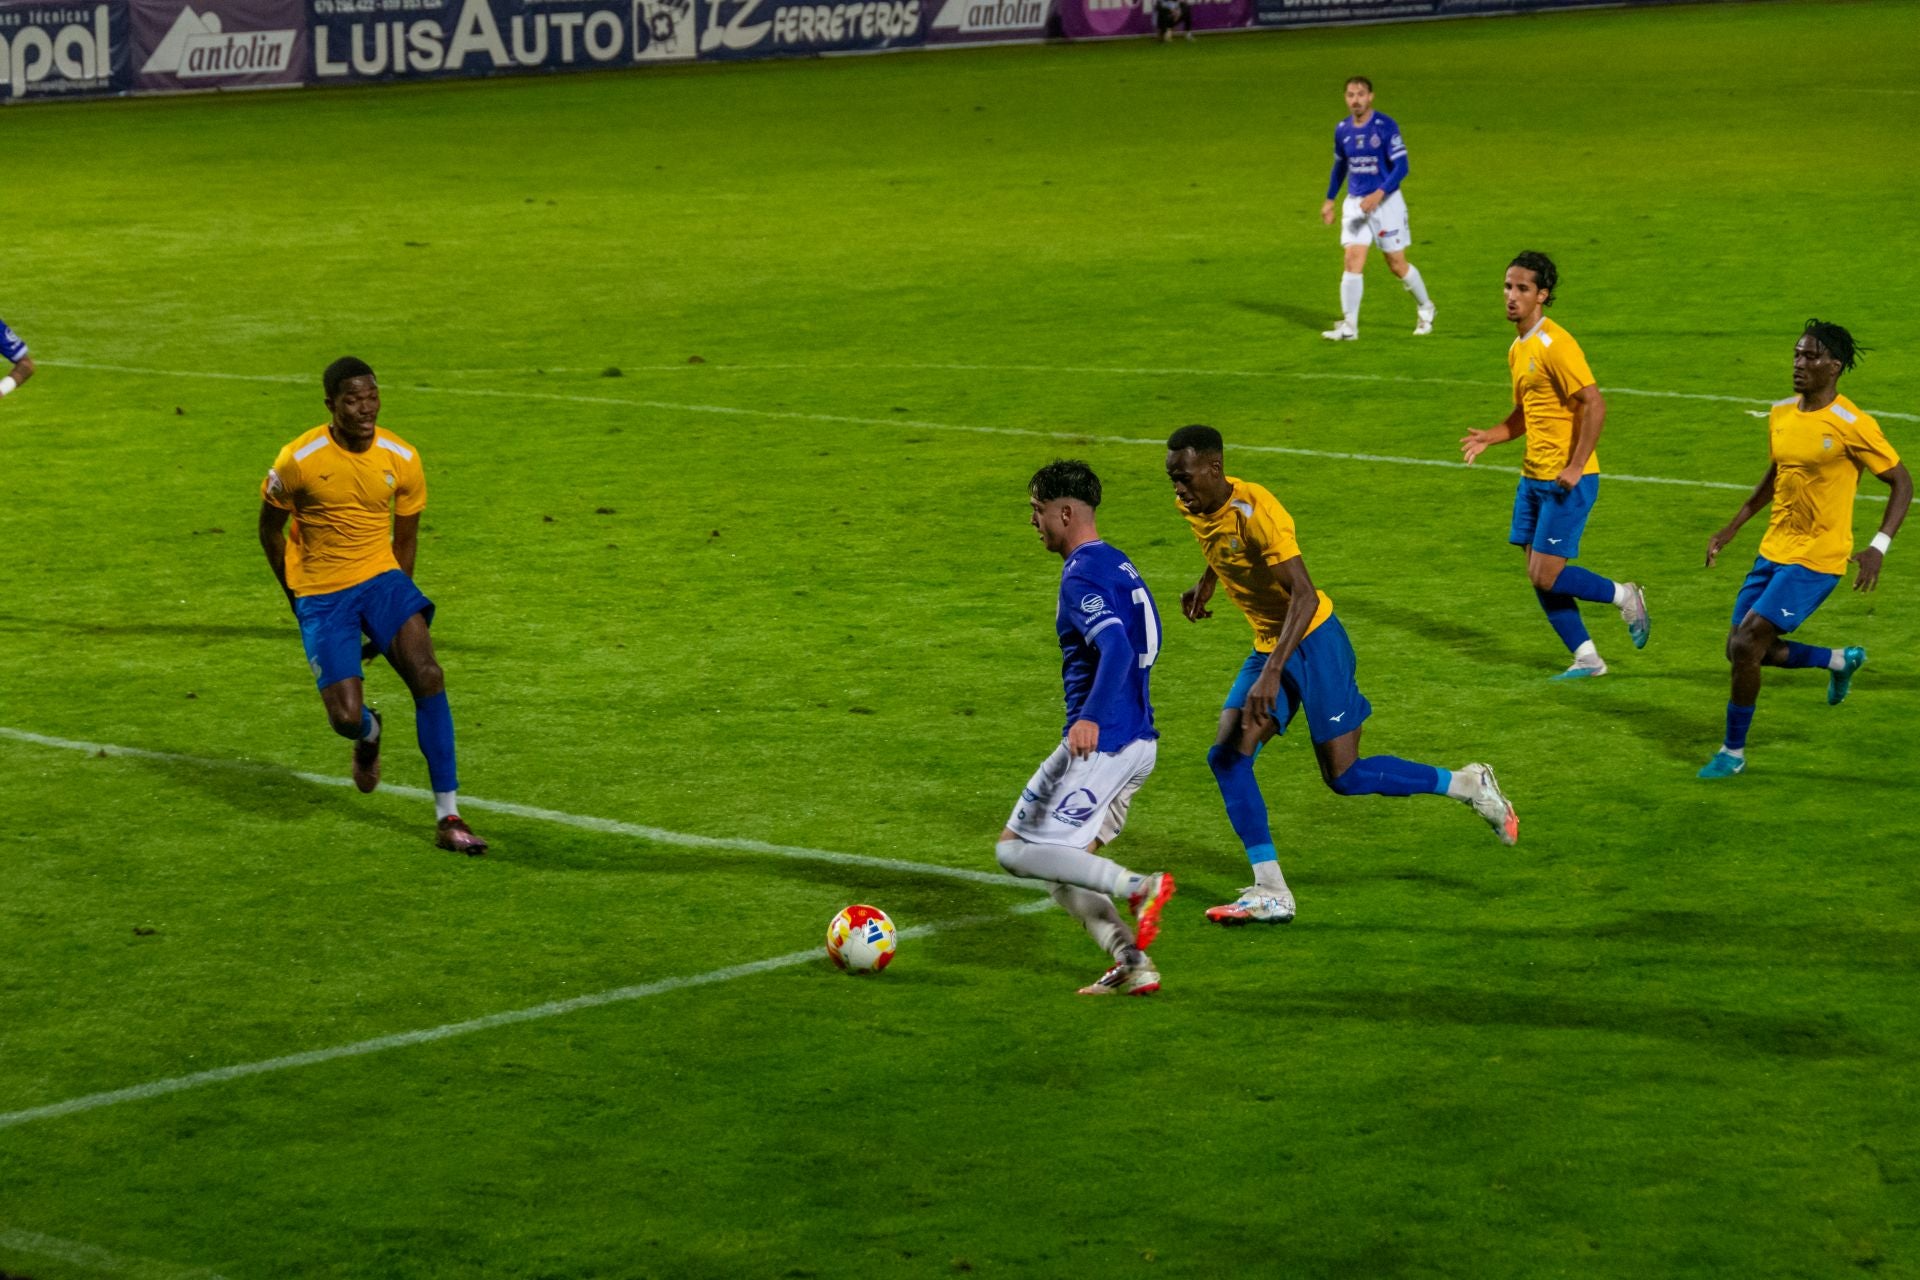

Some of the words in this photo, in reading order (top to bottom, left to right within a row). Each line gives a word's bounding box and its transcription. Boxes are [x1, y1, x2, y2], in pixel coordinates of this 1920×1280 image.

[774, 0, 920, 44] FERRETEROS
[968, 0, 1041, 27] antolin
[187, 35, 283, 73] antolin
